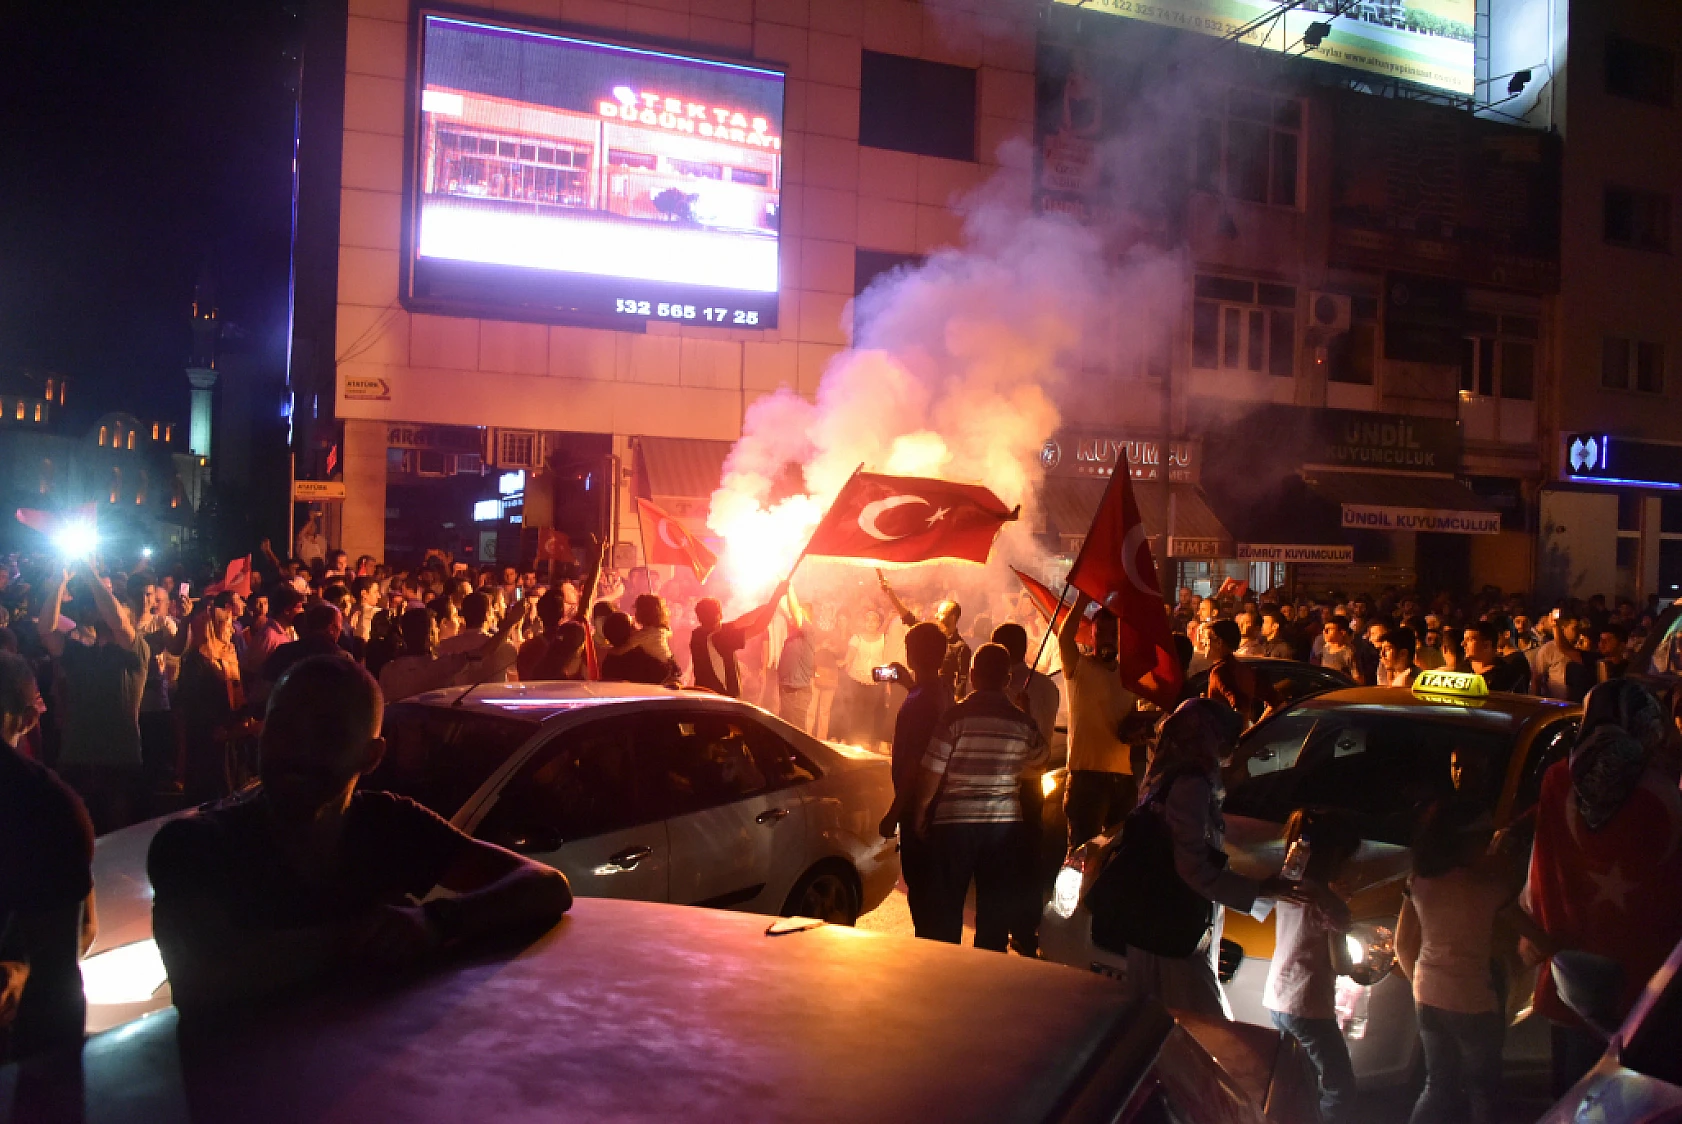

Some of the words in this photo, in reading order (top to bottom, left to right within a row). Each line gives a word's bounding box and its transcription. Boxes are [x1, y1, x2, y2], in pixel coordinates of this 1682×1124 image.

[657, 303, 696, 319] 565
[703, 307, 727, 322] 17
[733, 310, 758, 325] 25
[1324, 445, 1436, 467] KUYUMCULUK
[1149, 469, 1191, 481] AMET
[1344, 508, 1393, 527] ÜNDİL
[1397, 514, 1498, 532] KUYUMCULUK
[1238, 546, 1282, 559] ZÜMRÜT
[1285, 548, 1352, 561] KUYUMCULUK
